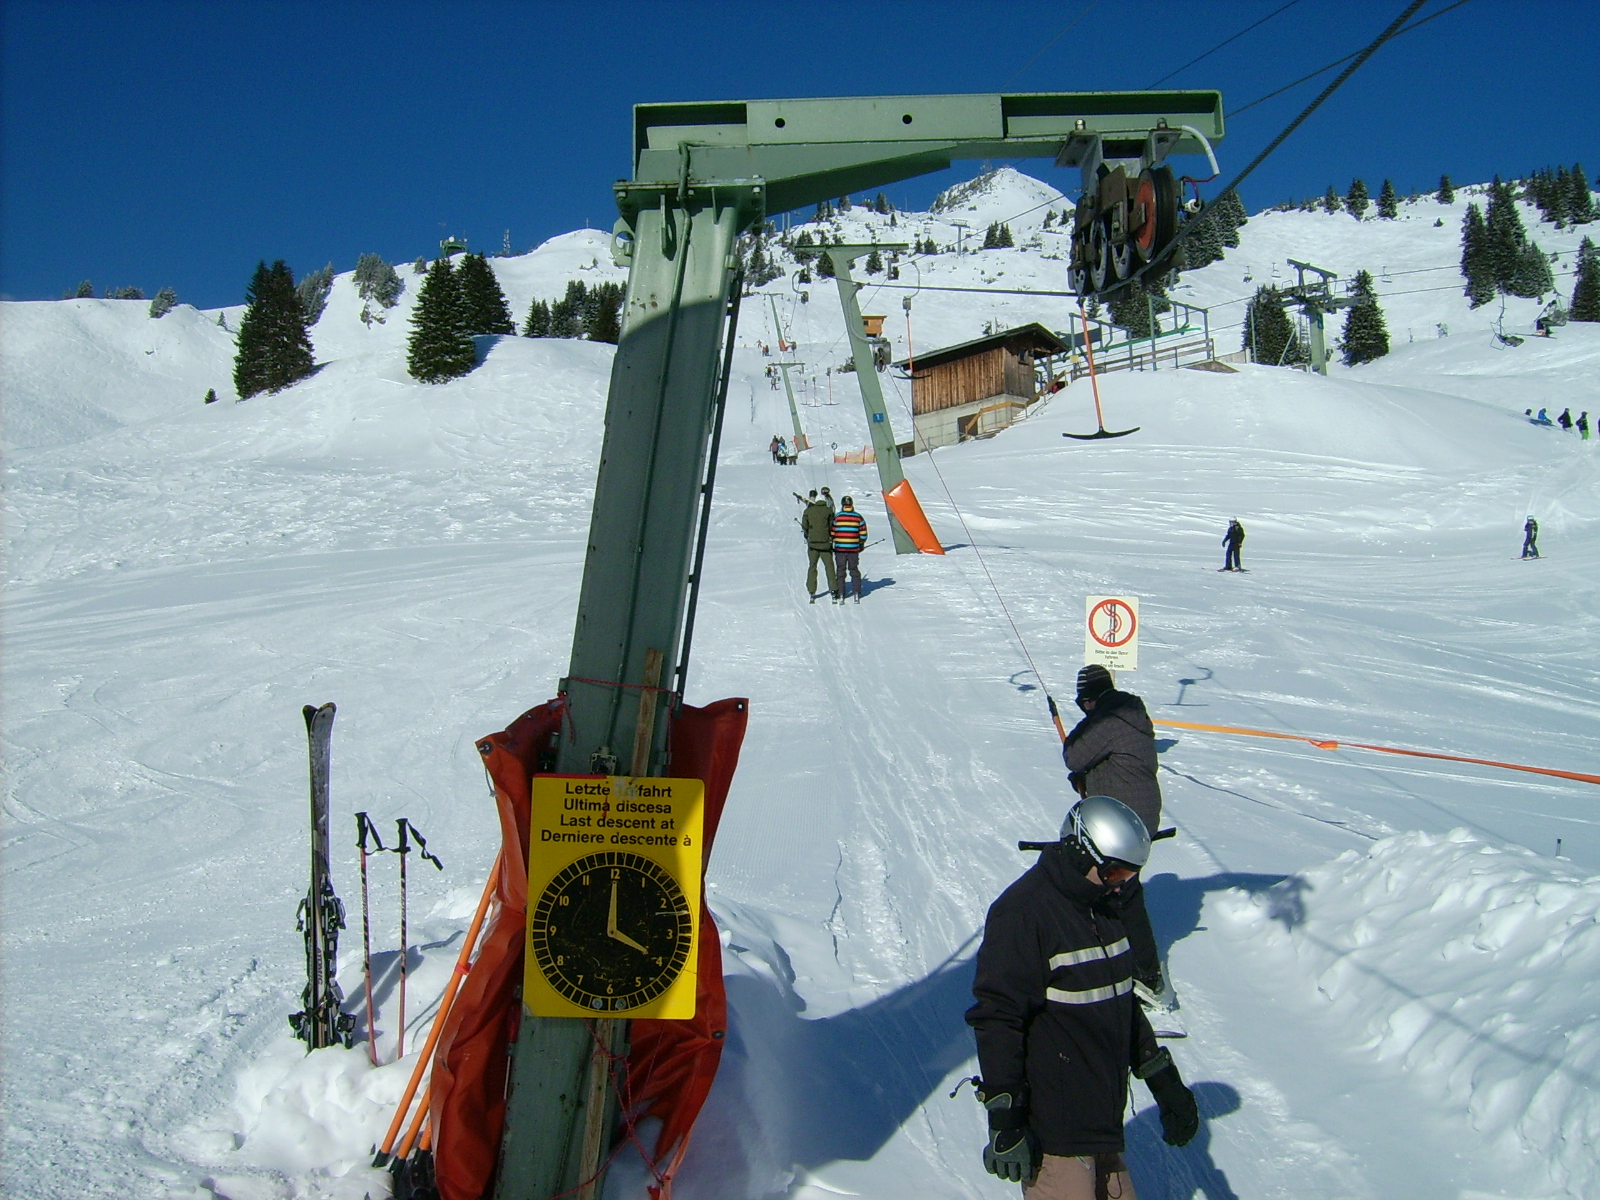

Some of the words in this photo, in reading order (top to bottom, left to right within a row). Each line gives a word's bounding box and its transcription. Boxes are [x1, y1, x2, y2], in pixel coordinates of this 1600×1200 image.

[565, 782, 611, 796] Letzte
[616, 784, 672, 797] fahrt
[564, 798, 611, 812] Ultima
[616, 800, 672, 814] discesa
[560, 814, 592, 827] Last
[596, 816, 656, 830] descent
[660, 818, 675, 830] at
[541, 829, 605, 844] Derniere
[610, 832, 678, 846] descente
[682, 835, 692, 847] à
[610, 868, 620, 880] 12
[582, 875, 590, 886] 11
[641, 877, 646, 888] 1
[559, 895, 570, 907] 10
[660, 898, 667, 909] 2
[549, 925, 557, 937] 9
[666, 929, 673, 940] 3
[556, 955, 564, 966] 8
[655, 956, 663, 967] 4
[576, 974, 584, 986] 7
[635, 976, 642, 987] 5
[606, 984, 614, 995] 6
